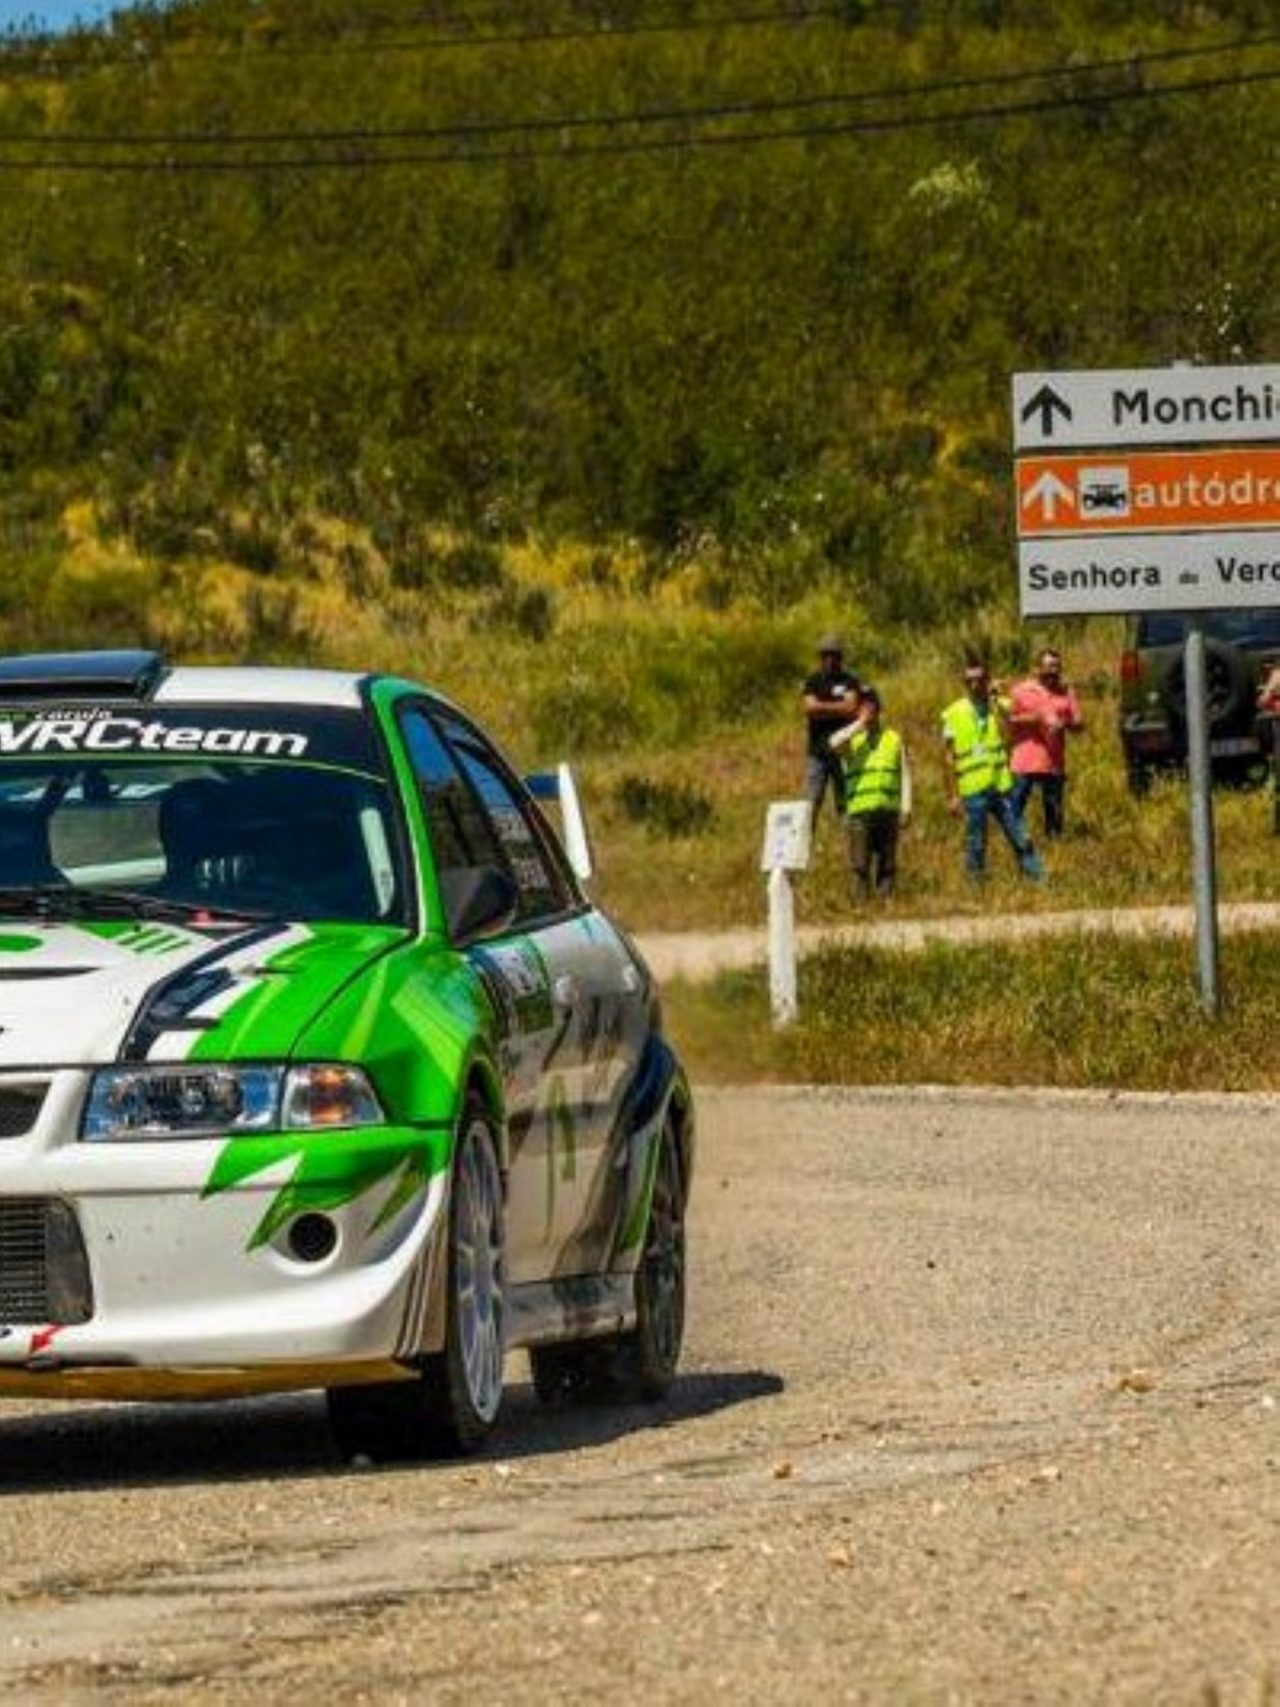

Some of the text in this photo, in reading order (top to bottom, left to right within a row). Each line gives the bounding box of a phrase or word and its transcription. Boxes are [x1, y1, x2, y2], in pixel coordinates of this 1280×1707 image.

[1112, 385, 1280, 425] Monchi
[1135, 471, 1280, 508] autódr
[1028, 562, 1161, 590] Senhora
